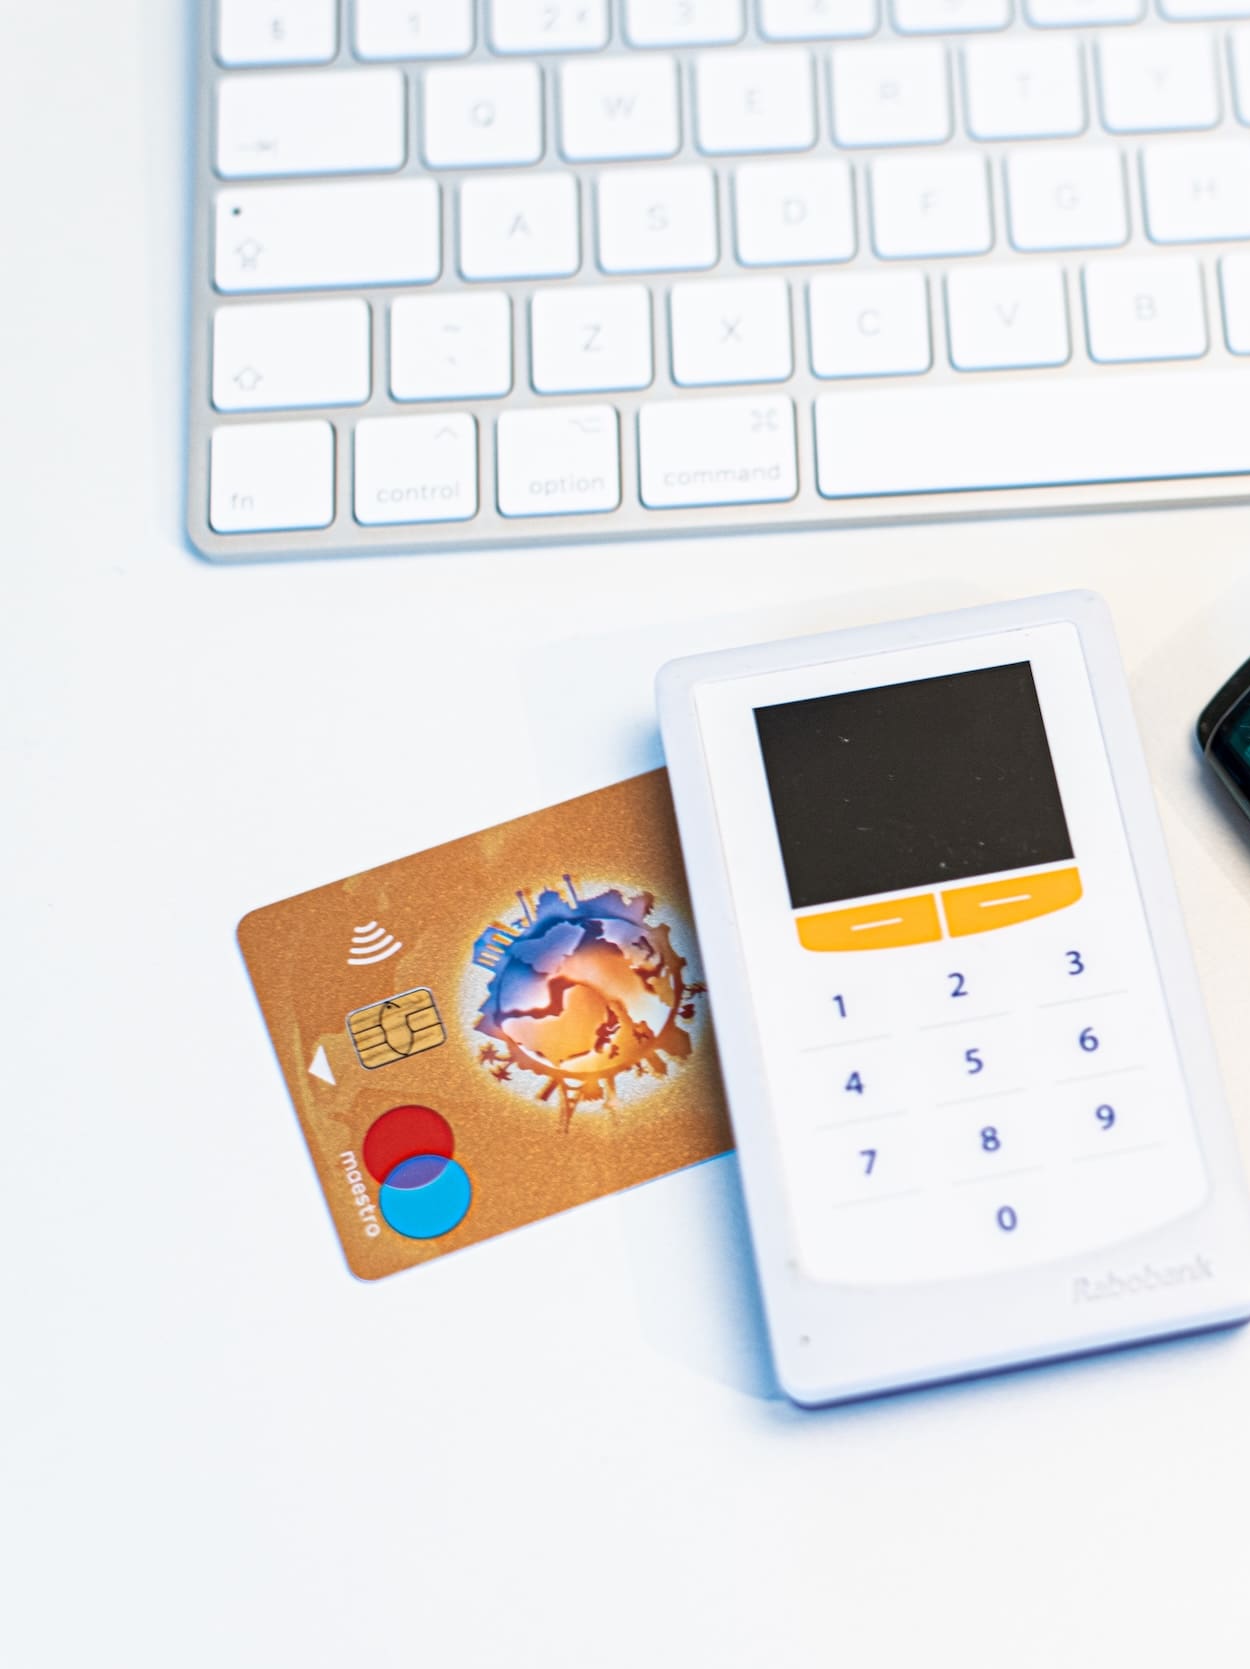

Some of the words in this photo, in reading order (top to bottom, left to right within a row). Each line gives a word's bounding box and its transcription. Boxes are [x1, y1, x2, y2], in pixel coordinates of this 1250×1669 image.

[1015, 72, 1032, 101] T
[1144, 65, 1173, 96] Y
[472, 102, 496, 128] Q
[604, 95, 637, 121] W
[742, 87, 759, 117] E
[919, 189, 941, 217] F
[1053, 182, 1081, 211] G
[1191, 176, 1218, 203] H
[507, 209, 533, 239] A
[646, 202, 670, 233] S
[780, 197, 808, 227] D
[994, 301, 1022, 329] V
[1133, 293, 1159, 323] B
[719, 315, 744, 345] X
[856, 307, 881, 338] C
[580, 323, 604, 353] Z
[529, 477, 604, 496] option
[664, 464, 781, 486] command
[231, 491, 255, 510] fn
[376, 482, 459, 503] control
[1065, 950, 1085, 976] 3
[948, 972, 968, 998] 2
[832, 994, 847, 1018] 1
[1078, 1026, 1100, 1053] 6
[964, 1047, 984, 1075] 5
[844, 1071, 864, 1095] 4
[1095, 1104, 1116, 1130] 9
[980, 1126, 1001, 1153] 8
[859, 1148, 877, 1175] 7
[339, 1150, 381, 1237] maestro
[995, 1205, 1018, 1233] 0
